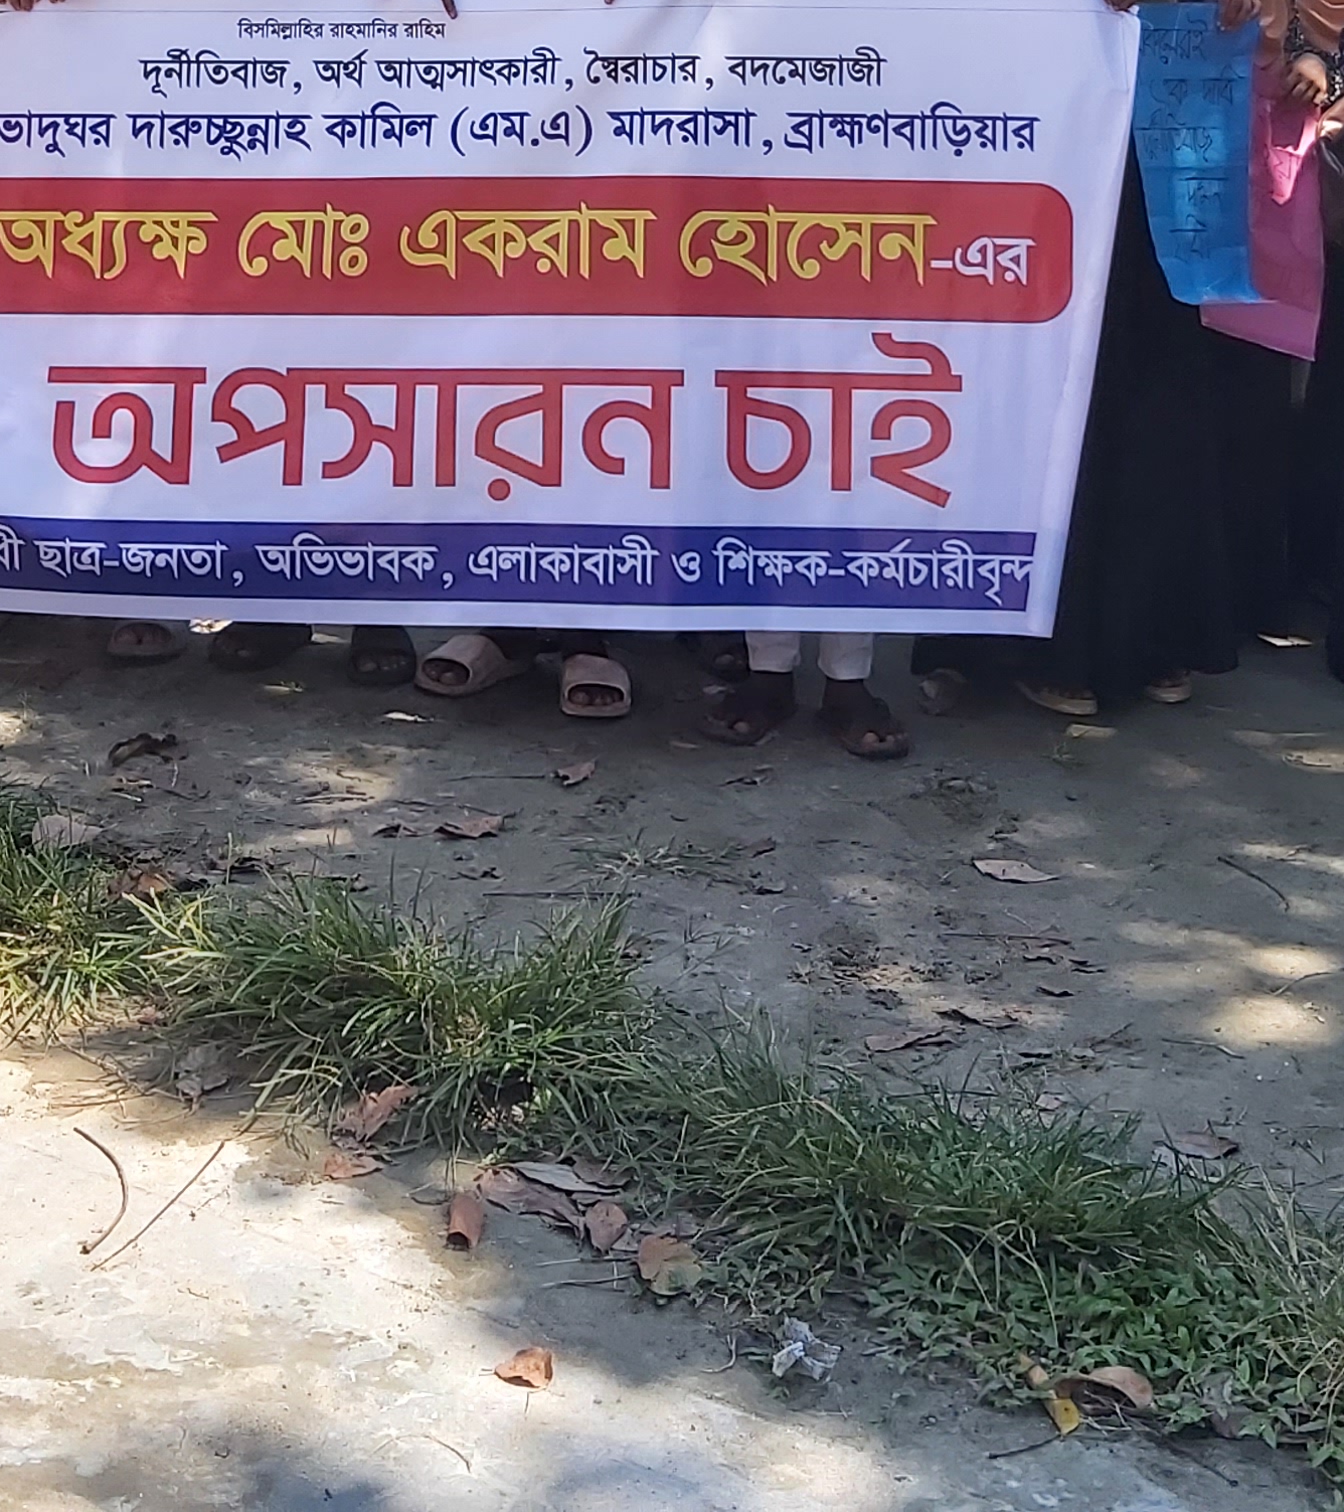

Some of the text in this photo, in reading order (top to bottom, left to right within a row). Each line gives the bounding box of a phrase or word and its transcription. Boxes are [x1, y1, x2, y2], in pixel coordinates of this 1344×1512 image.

[238, 18, 447, 40] বিসমিল্লাহির রাহমানির রাহিম
[313, 49, 368, 89] অর্থ
[374, 47, 574, 92] আত্মসাৎকারী,
[583, 46, 715, 91] স্বৈরাচার,
[724, 45, 888, 87] বদমেজাজী
[321, 101, 439, 148] কামিল
[450, 104, 593, 157] (এম.এ)
[606, 106, 773, 156] মাদরাসা,
[784, 101, 1041, 158] ব্রাহ্মণবাড়িয়ার
[237, 203, 370, 282] মোঃ
[399, 200, 658, 282] একরাম
[678, 203, 1036, 288] হোসেন-এর
[46, 331, 963, 509] অপসারন চাই
[255, 532, 455, 590] অভিভাবক,
[468, 534, 659, 586] এলাকাবাসী
[671, 551, 701, 582] ও
